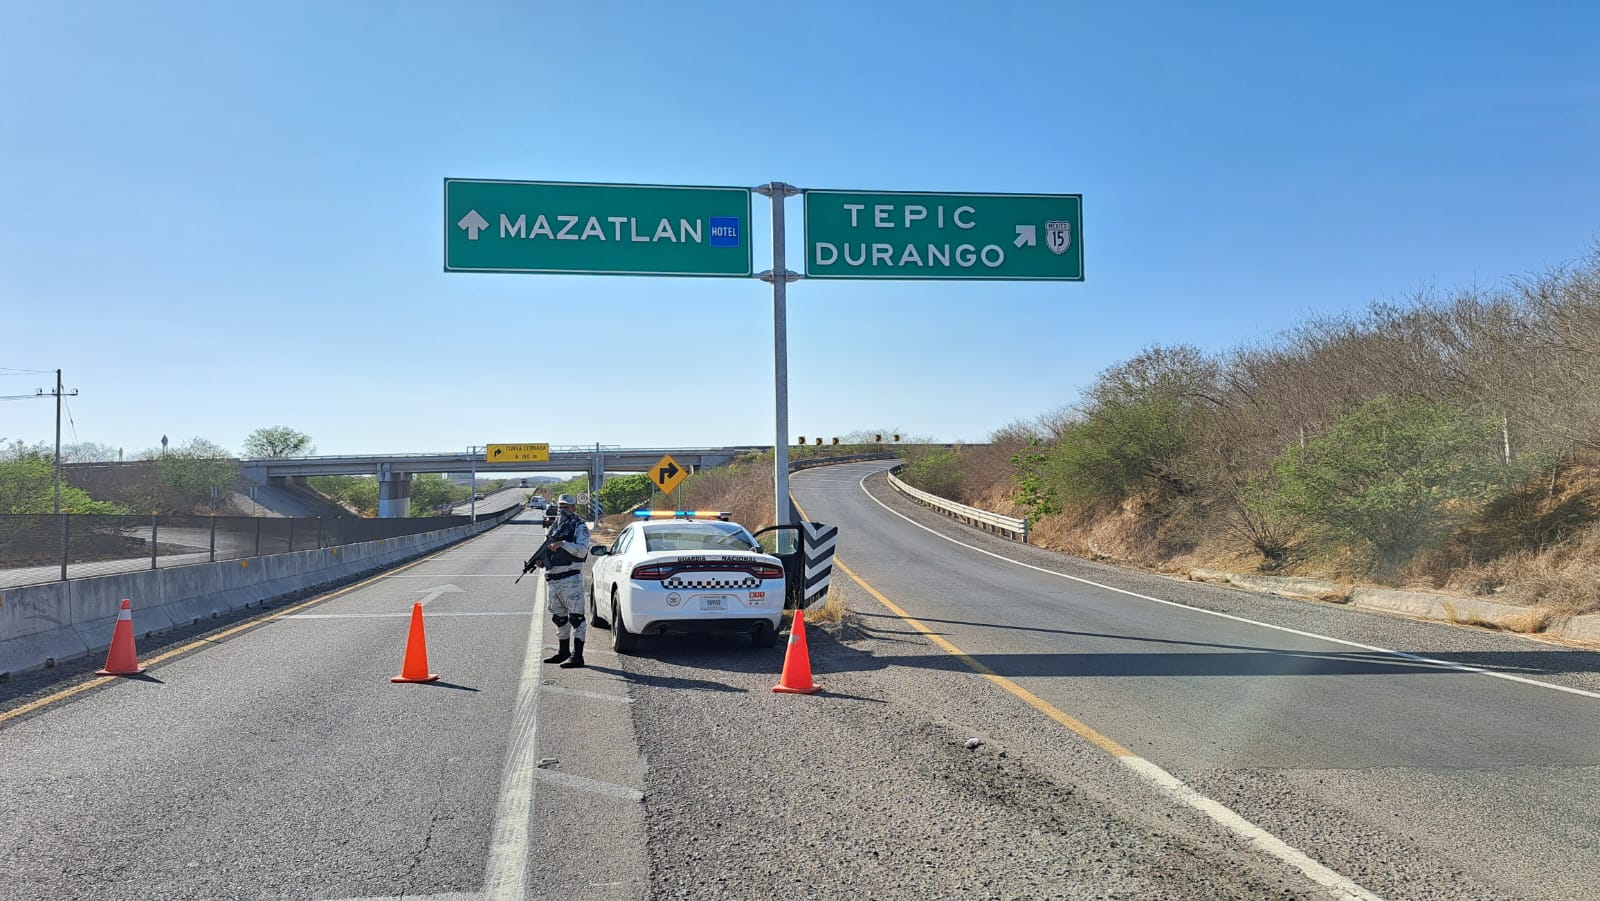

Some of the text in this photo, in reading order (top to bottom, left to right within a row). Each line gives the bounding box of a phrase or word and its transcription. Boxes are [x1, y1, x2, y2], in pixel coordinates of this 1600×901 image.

[499, 213, 703, 243] MAZATLAN
[843, 203, 977, 230] TEPIC
[711, 226, 737, 237] HOTEL
[1052, 231, 1065, 247] 15
[815, 242, 1005, 268] DURANGO
